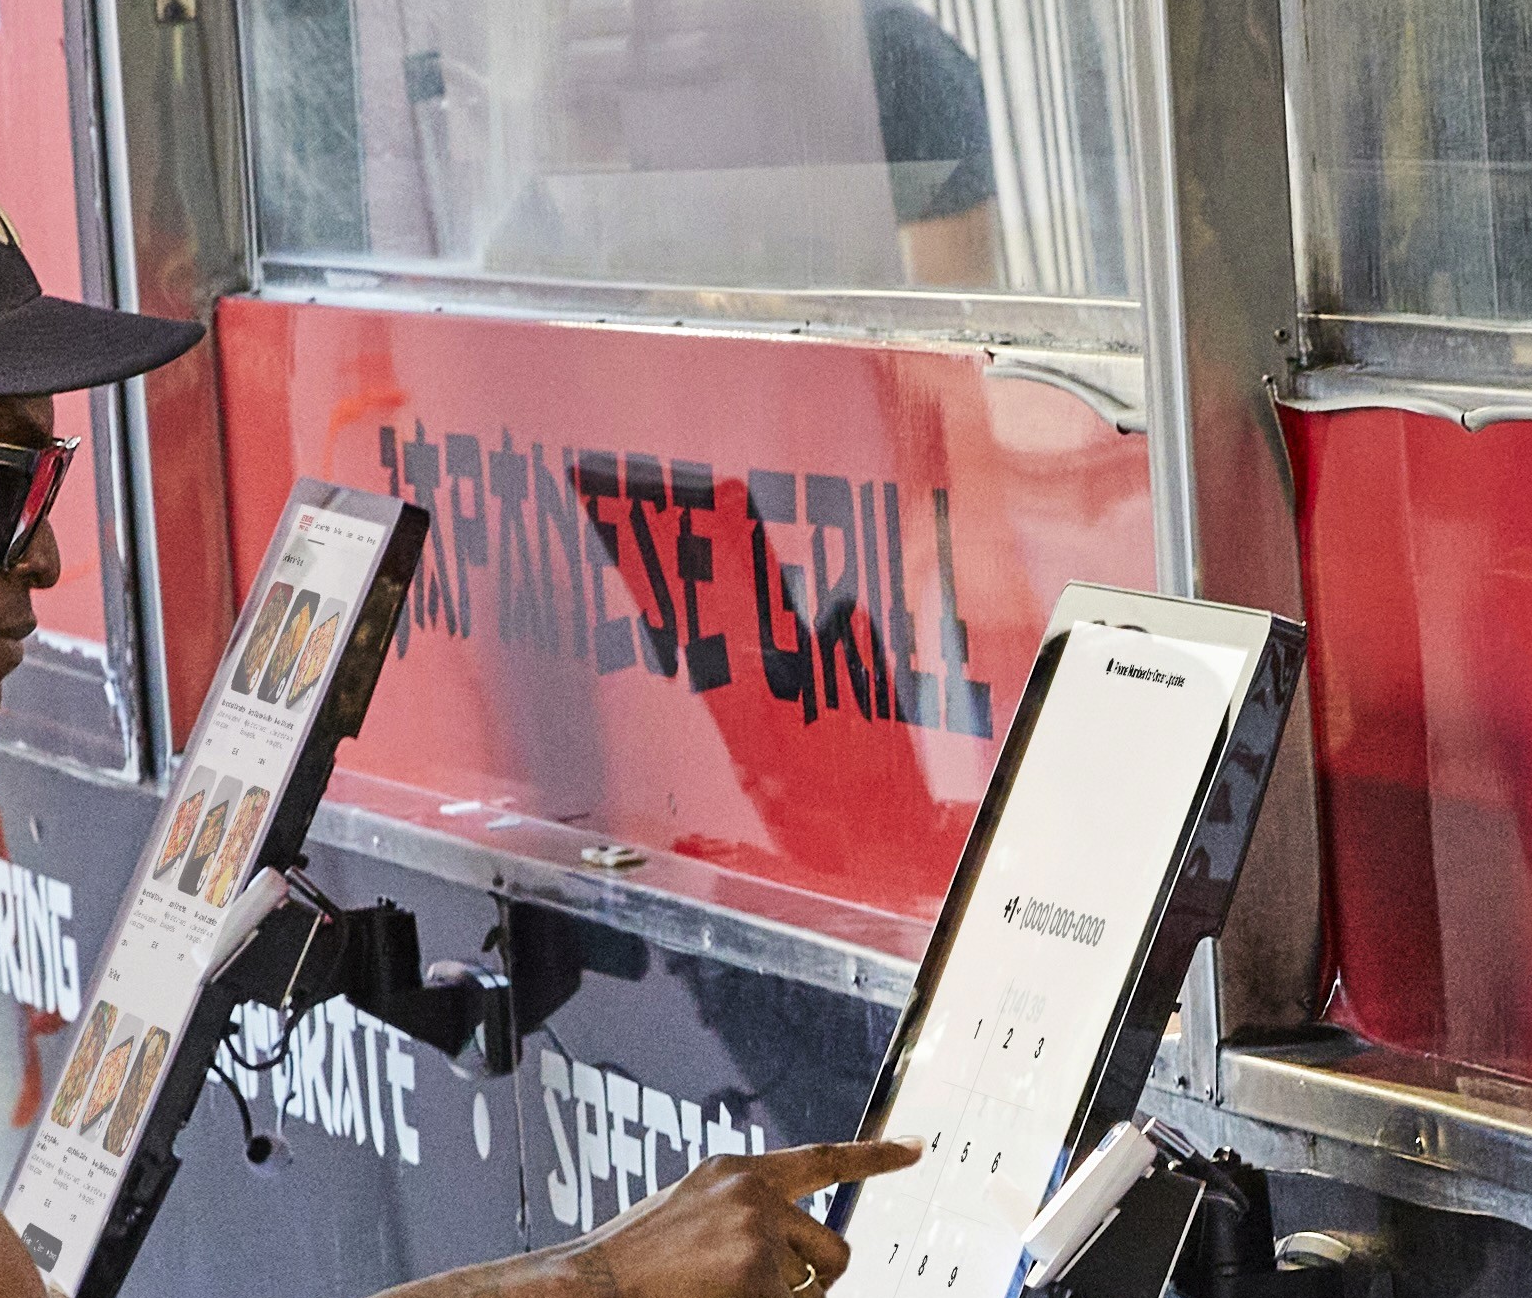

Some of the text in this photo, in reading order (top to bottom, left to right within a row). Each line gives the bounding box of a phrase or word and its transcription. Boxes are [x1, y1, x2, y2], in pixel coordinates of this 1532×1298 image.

[747, 471, 993, 740] GRILL
[974, 1019, 1045, 1058] 1 2 3
[207, 993, 420, 1166] RPORATE
[932, 1132, 1001, 1173] 4 5 6
[889, 1243, 958, 1287] 7 8 9
